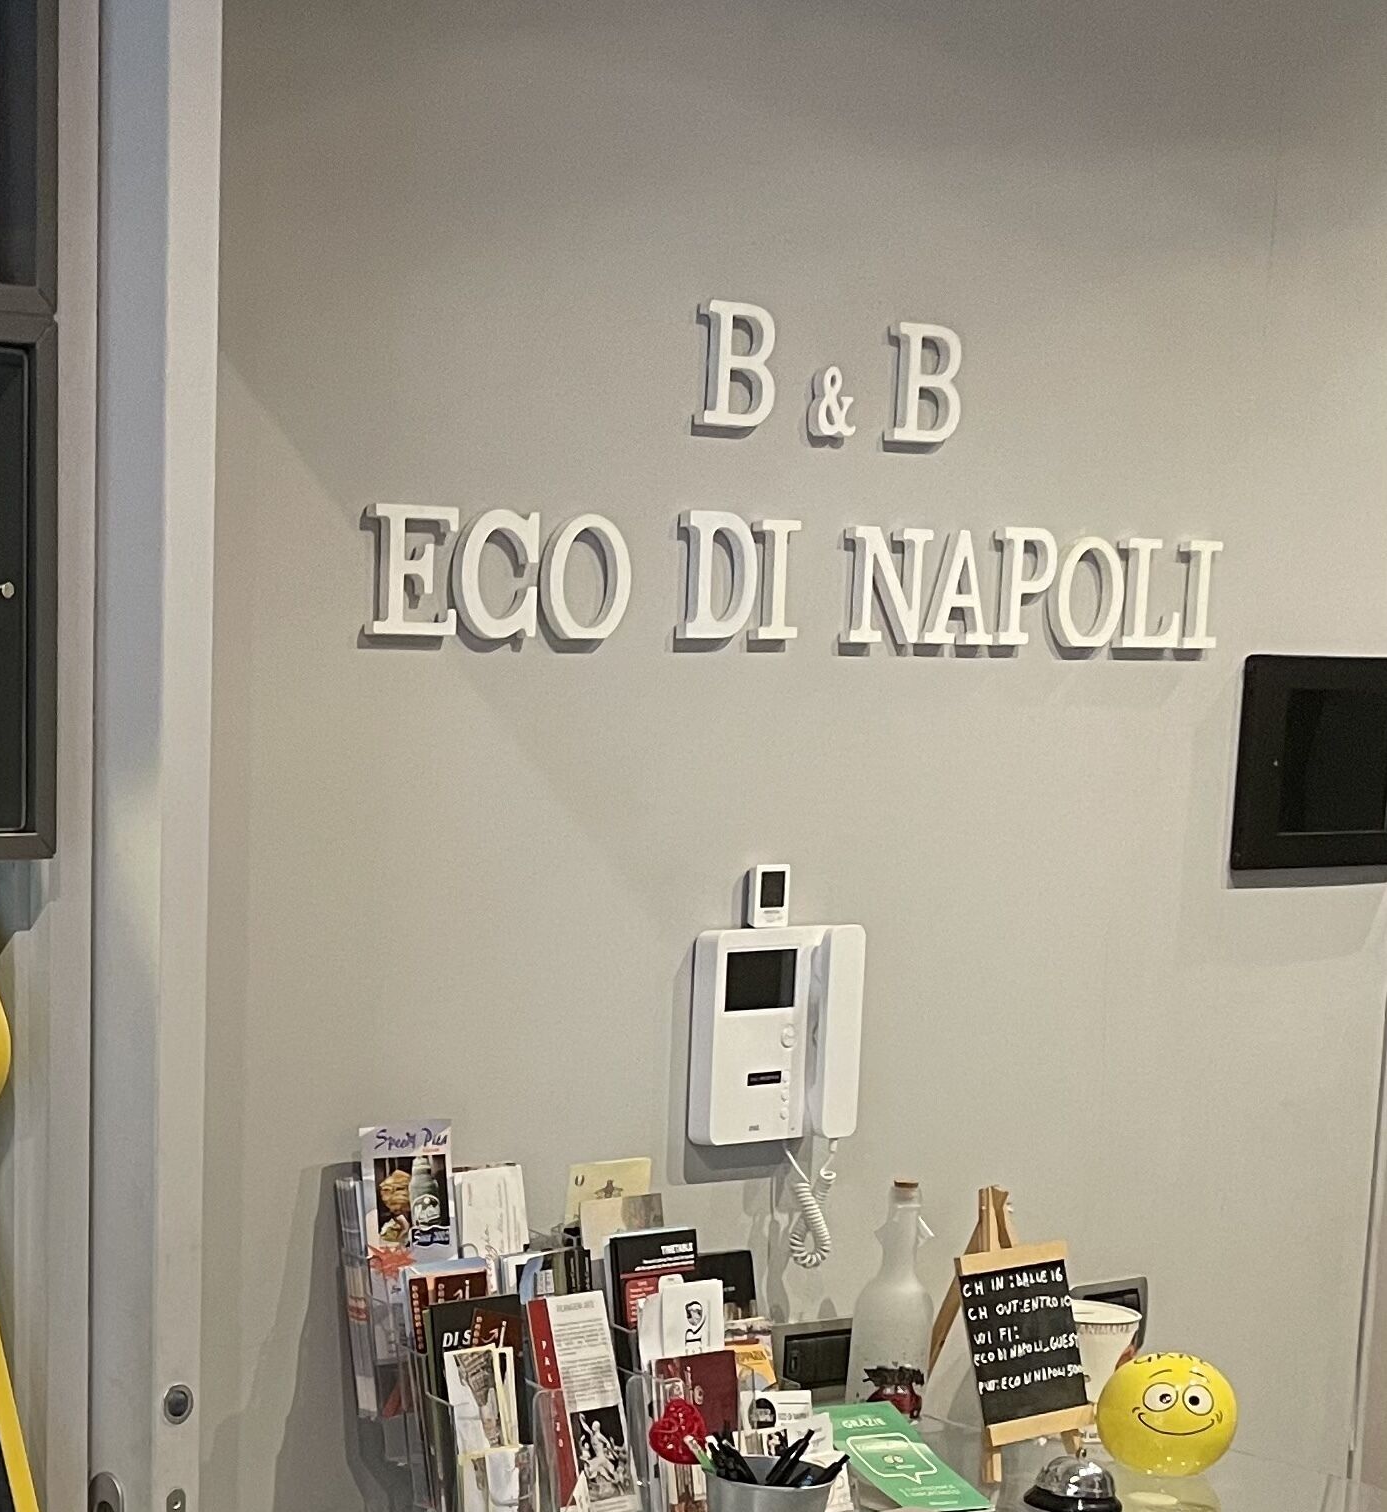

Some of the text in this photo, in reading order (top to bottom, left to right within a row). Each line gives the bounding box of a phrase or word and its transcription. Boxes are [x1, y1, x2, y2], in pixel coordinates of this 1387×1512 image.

[701, 299, 963, 443] B & B
[366, 503, 1224, 648] ECO DI NAPOLI
